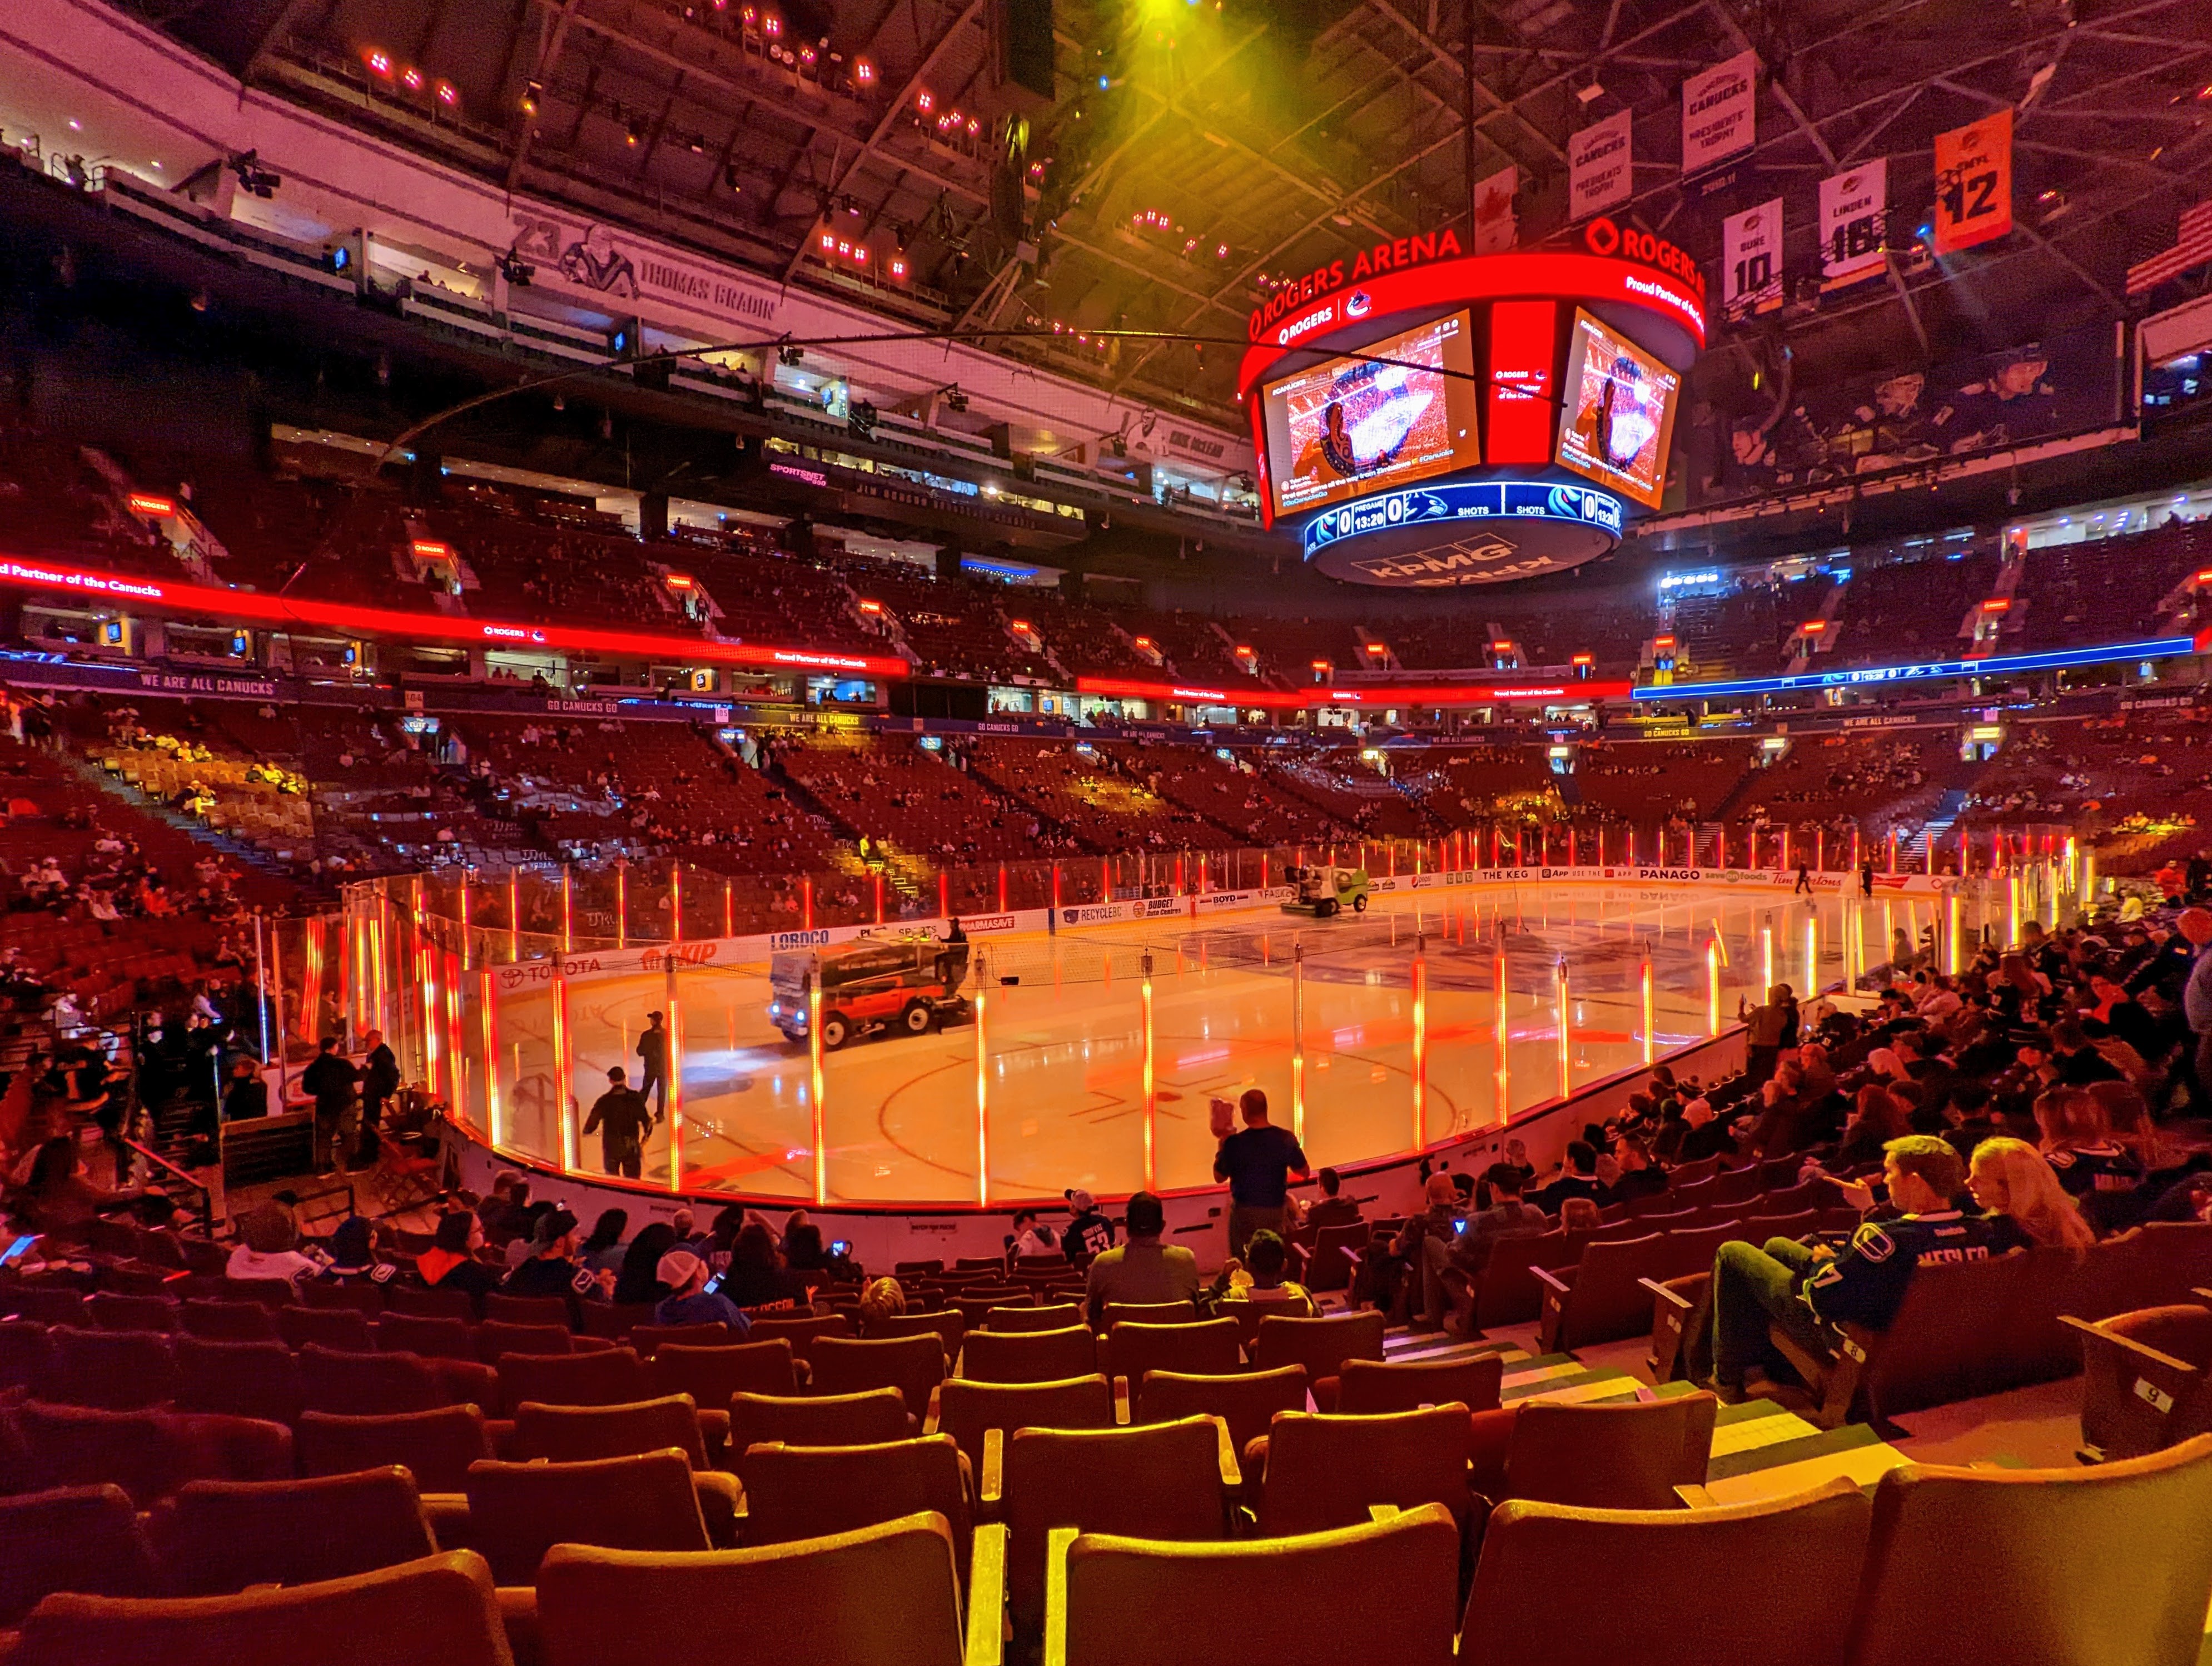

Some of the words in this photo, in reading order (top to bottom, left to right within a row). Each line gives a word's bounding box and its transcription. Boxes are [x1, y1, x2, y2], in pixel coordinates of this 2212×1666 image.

[1689, 78, 1748, 116] CANUCKS
[1576, 136, 1626, 167] CANUCKS
[1833, 195, 1871, 217] LINDEN
[1944, 170, 1997, 225] 12
[1740, 236, 1766, 252] BURE
[1623, 229, 1696, 285] ROGERS
[640, 258, 711, 300] THOMAS
[1264, 260, 1344, 327] ROGERS
[1351, 229, 1462, 280] ARENA
[1735, 252, 1772, 295] 10
[1626, 276, 1655, 295] Proud
[1656, 284, 1682, 309] Partner
[1682, 300, 1689, 310] of
[1289, 307, 1333, 339] ROGERS
[1272, 379, 1307, 396] #CANUCKS
[1376, 461, 1411, 474] Zimbabwe
[1419, 448, 1454, 463] #Canucks
[770, 463, 826, 481] SPORTSNET
[1283, 490, 1329, 507] #GoCanucksGo
[1355, 500, 1384, 513] PREGAME
[1584, 495, 1595, 518] 0
[1388, 498, 1403, 522] 0
[1458, 505, 1489, 517] SHOTS
[1517, 505, 1545, 515] SHOTS
[1340, 510, 1351, 534] 0
[1355, 512, 1384, 530] 13:20
[1370, 543, 1513, 579] KPMG
[12, 565, 64, 583] Partner
[66, 574, 82, 585] of
[83, 576, 107, 589] the
[108, 580, 162, 597] Canucks
[493, 628, 525, 637] ROGERS
[775, 652, 796, 662] Proud
[796, 654, 819, 664] Partner
[840, 658, 867, 668] Canucks
[141, 673, 160, 687] WE
[163, 675, 187, 690] ARE
[191, 677, 213, 691] ALL
[217, 679, 274, 695] CANUCKS
[548, 700, 559, 711] GO
[563, 701, 603, 713] CANUCKS
[605, 703, 618, 713] GO
[715, 709, 728, 717] 105
[789, 713, 800, 722] WE
[801, 714, 814, 723] ARE
[816, 715, 828, 724] ALL
[829, 715, 860, 726] CANUCKS
[986, 723, 1011, 732] CANUCKS
[1653, 729, 1680, 737] CANUCKS
[1483, 871, 1502, 880] THE
[1506, 870, 1529, 879] KEG
[1639, 869, 1700, 880] PANAGO
[1739, 871, 1767, 880] foods
[1772, 872, 1793, 884] Tim
[1147, 898, 1174, 910] BUDGET
[1213, 895, 1236, 904] BOYD
[1081, 906, 1122, 921] RECYCLEBC
[528, 958, 601, 982] TOOTA
[1085, 1231, 1111, 1254] 53
